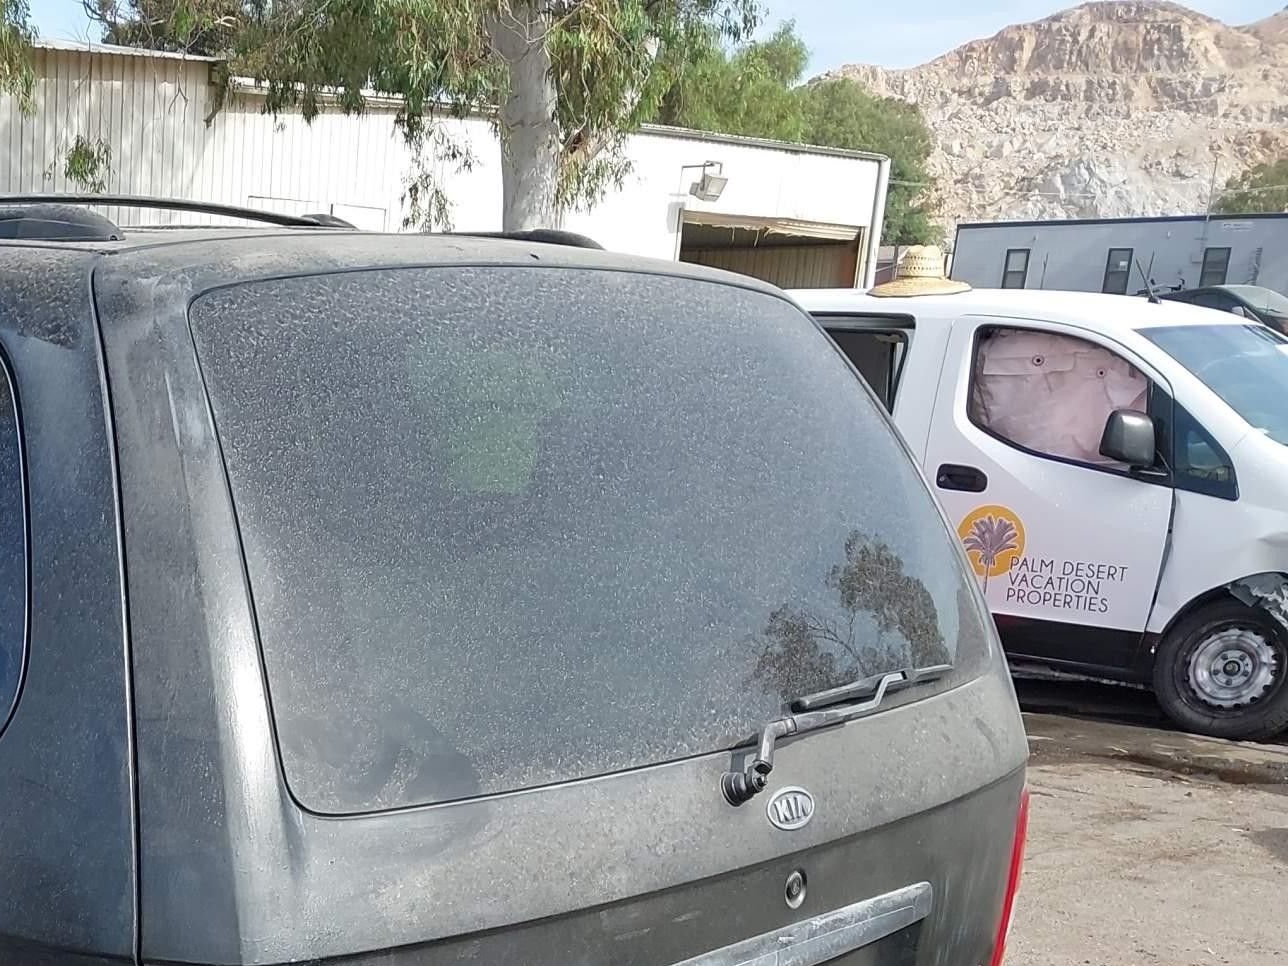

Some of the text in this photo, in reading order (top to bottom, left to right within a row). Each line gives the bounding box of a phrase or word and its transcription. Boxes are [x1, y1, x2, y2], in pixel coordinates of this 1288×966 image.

[1009, 556, 1129, 583] PALM DESERT
[1008, 571, 1101, 596] VACATION
[1005, 587, 1109, 614] PROPERTIES
[772, 794, 811, 824] KIA
